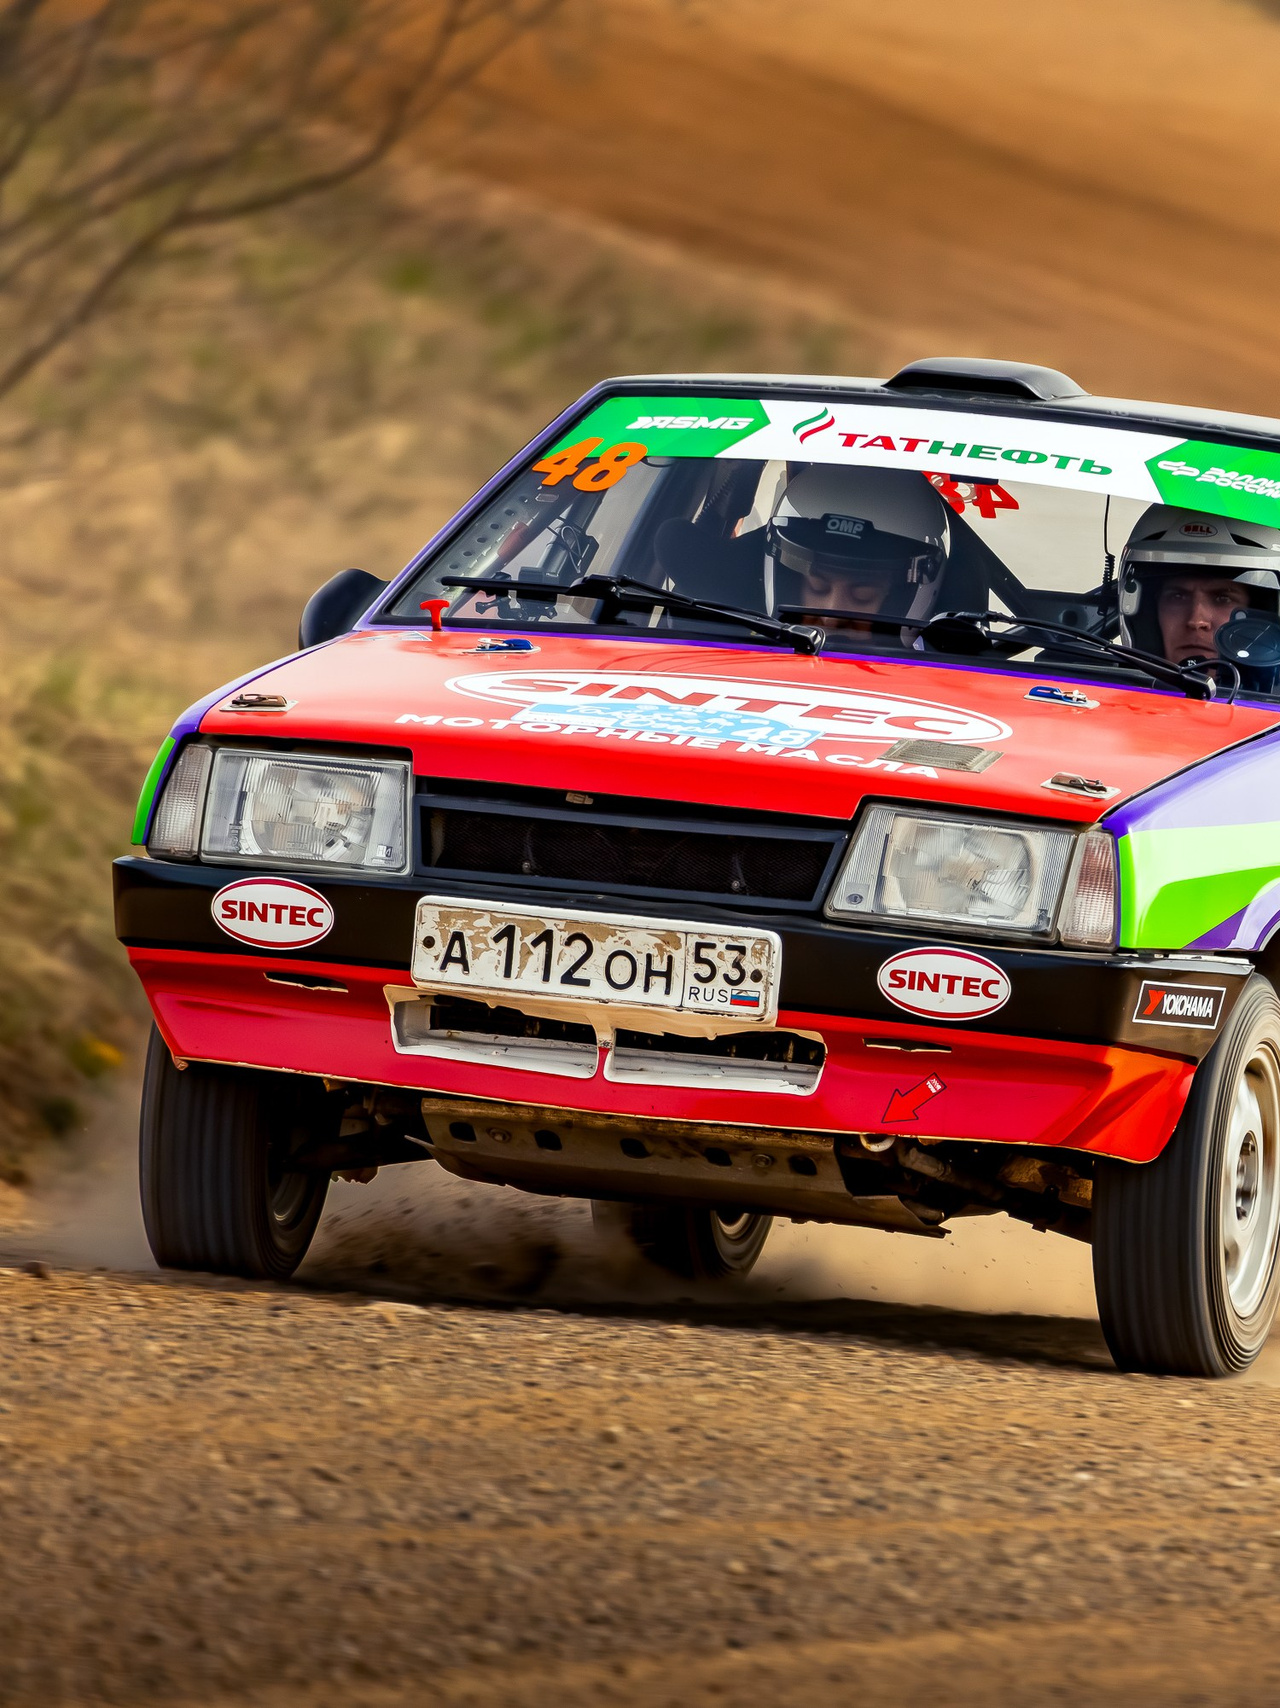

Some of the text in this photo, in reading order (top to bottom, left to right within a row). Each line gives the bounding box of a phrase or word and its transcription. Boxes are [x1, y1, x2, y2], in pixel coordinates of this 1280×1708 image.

[531, 437, 648, 492] 48
[838, 432, 1113, 476] ТАТНЕФТЬ
[827, 519, 864, 534] OMP
[488, 678, 969, 735] SINTEC
[394, 713, 940, 779] МОТОРНЫЕ МАСЛА
[731, 725, 812, 746] 48
[220, 898, 325, 929] SINTEC
[693, 941, 747, 986] 53
[688, 986, 728, 1004] RUS
[887, 968, 1001, 999] SINTEC
[1161, 992, 1214, 1018] YOKOHAMA
